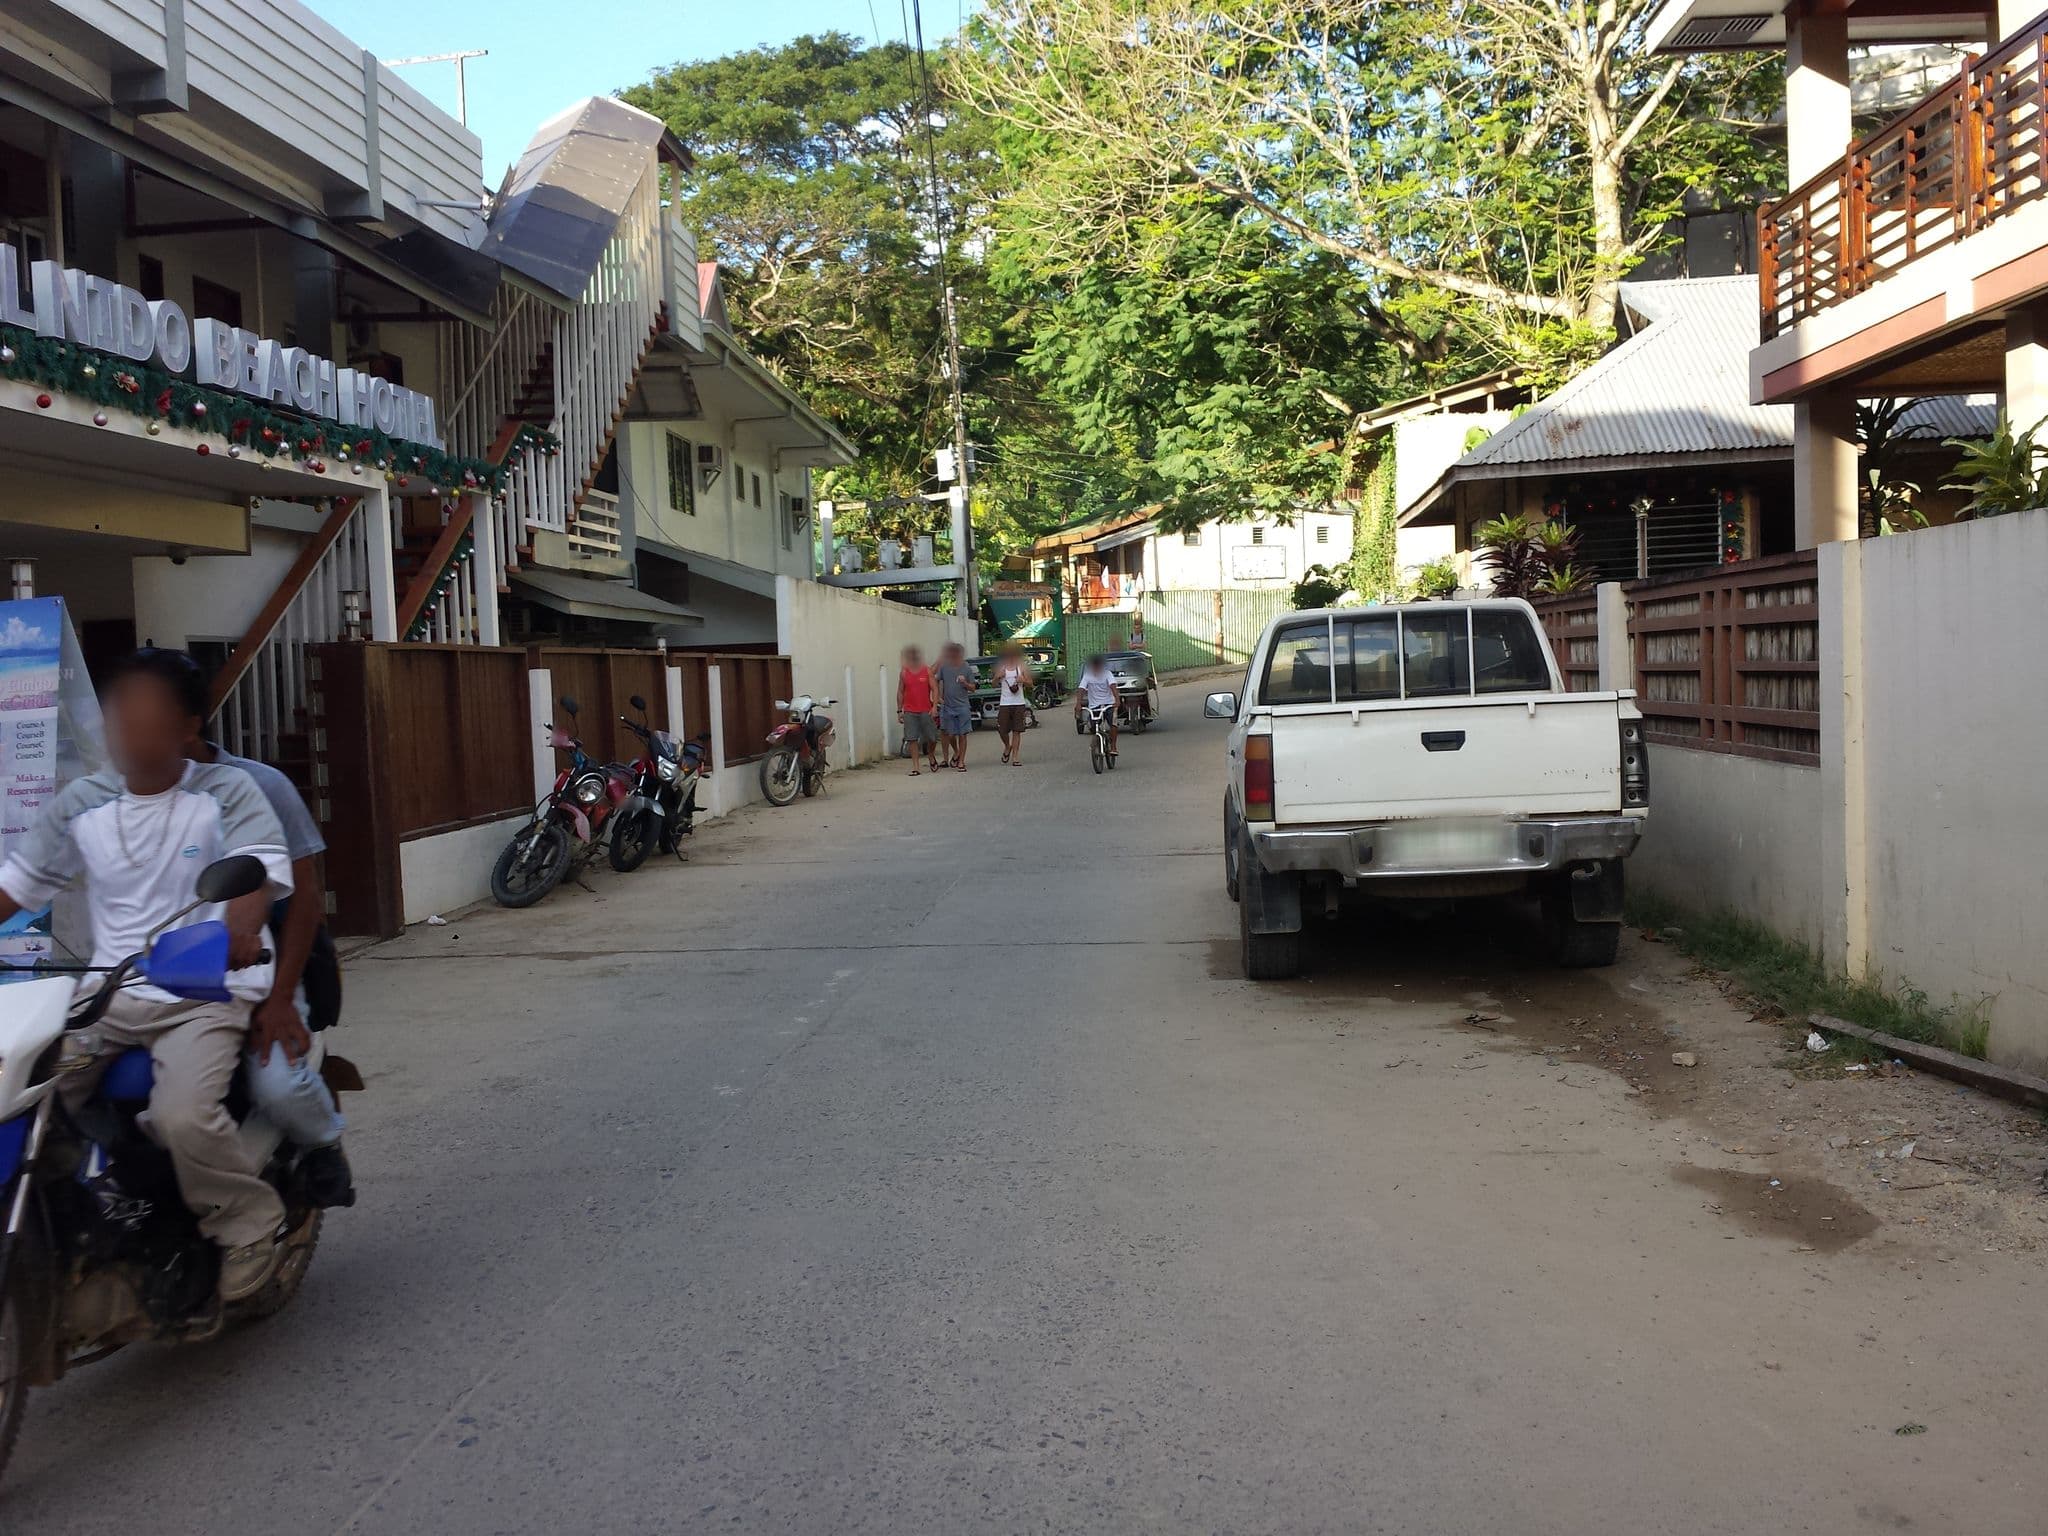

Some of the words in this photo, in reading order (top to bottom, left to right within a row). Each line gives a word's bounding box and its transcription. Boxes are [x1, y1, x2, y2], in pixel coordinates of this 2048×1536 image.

[31, 260, 190, 372] NIDO
[194, 318, 338, 421] BEACH
[337, 368, 446, 452] HOTEL
[16, 773, 39, 783] Make
[7, 786, 54, 796] Reservation
[20, 799, 40, 808] Now
